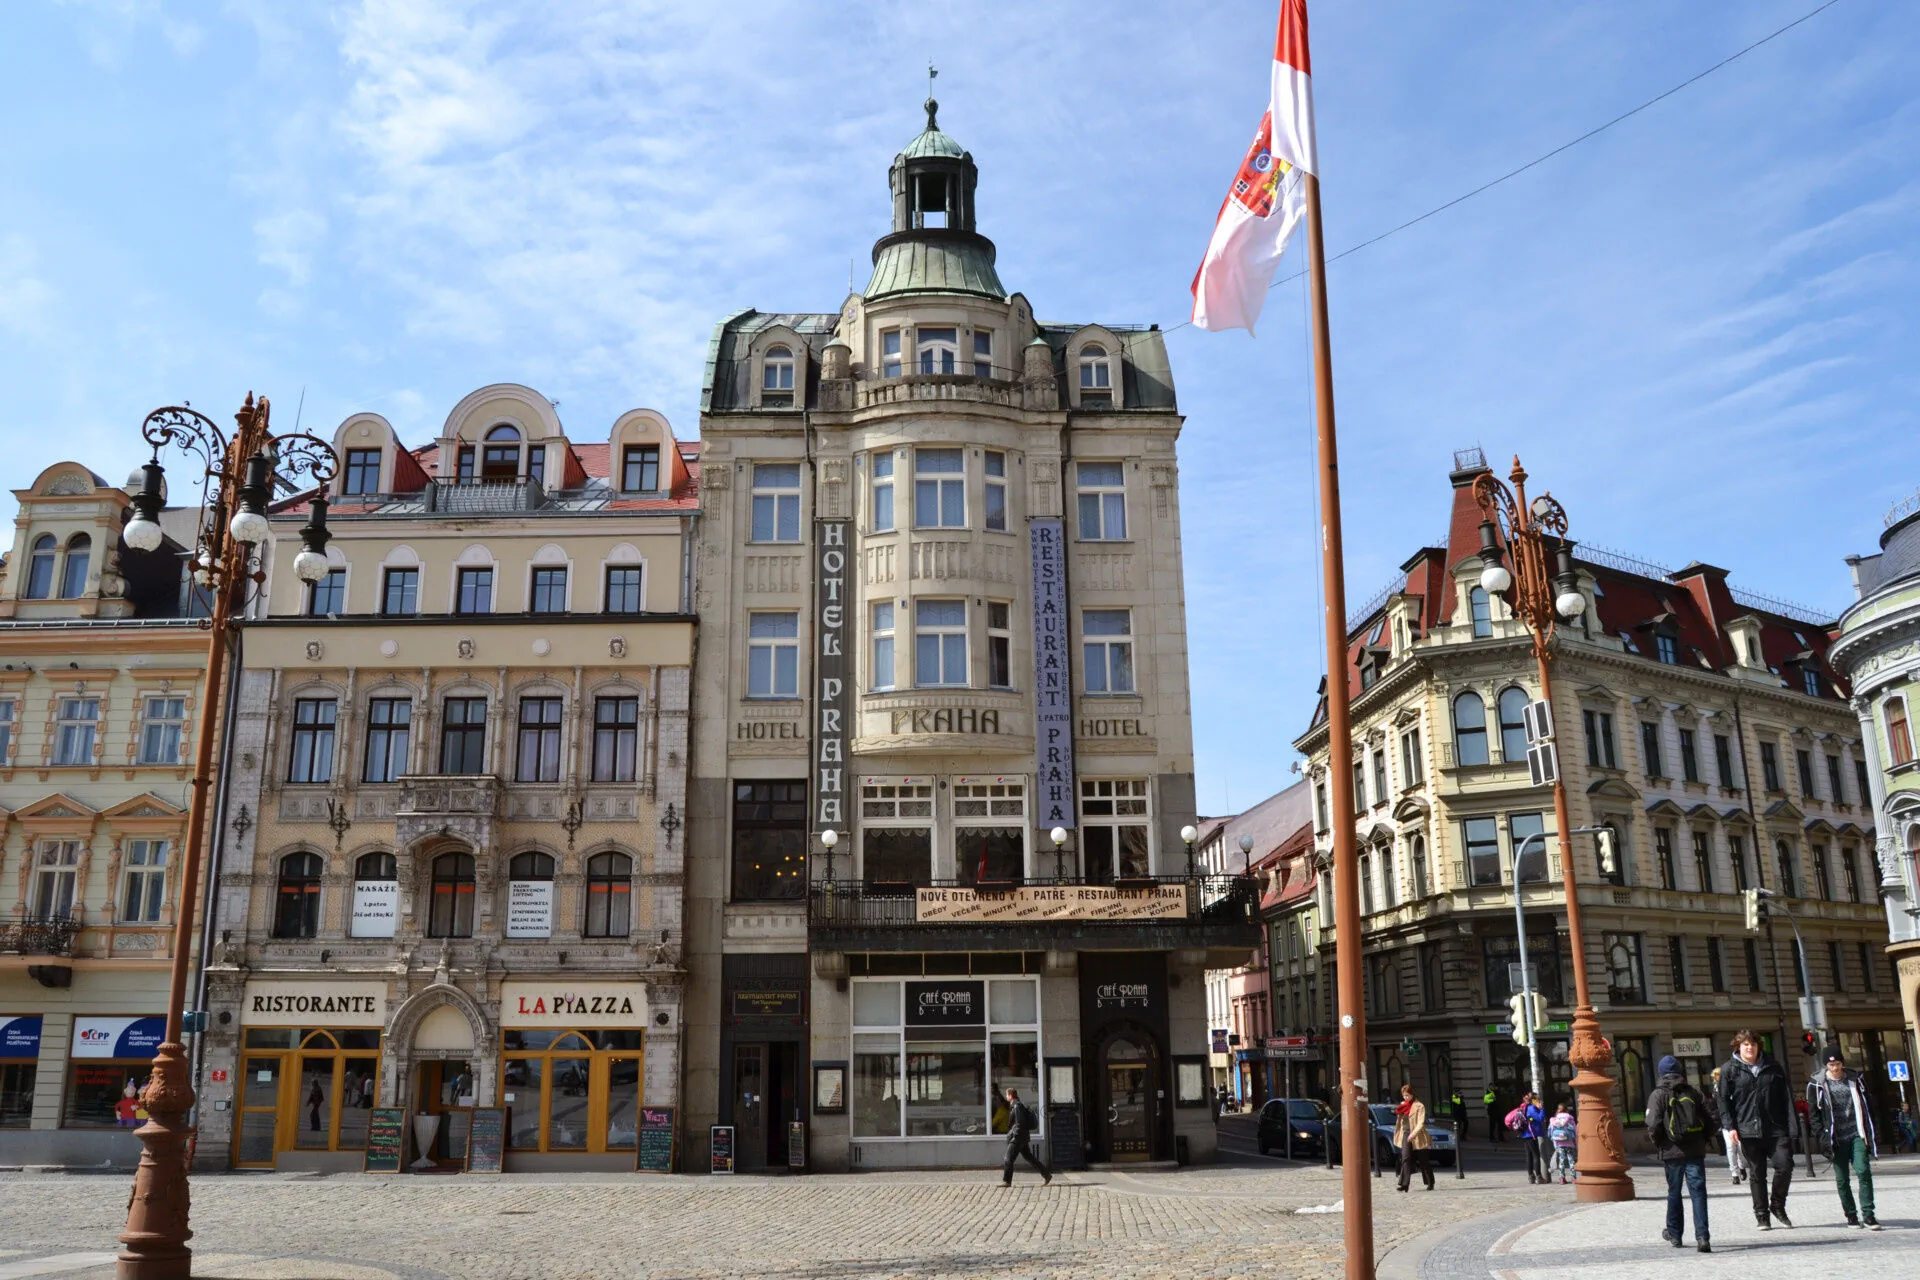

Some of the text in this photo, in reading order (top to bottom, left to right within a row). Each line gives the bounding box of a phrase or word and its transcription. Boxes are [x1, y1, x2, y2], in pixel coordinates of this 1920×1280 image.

[1040, 528, 1060, 706] RESTAURANT
[820, 524, 844, 822] HOTEL PRAHA
[891, 708, 999, 734] PRAHA
[1045, 714, 1069, 722] PATRO
[737, 722, 804, 739] HOTEL
[1081, 719, 1148, 736] HOTEL
[1047, 728, 1065, 820] PRAHA
[920, 890, 948, 902] NOVĚ
[1020, 890, 1029, 901] 1.
[1034, 888, 1065, 900] PATŘE
[1078, 889, 1143, 900] RESTAURANT
[1148, 888, 1182, 899] PRAHA
[922, 905, 948, 918] OBĚDY
[951, 904, 981, 918] VEČEŘE
[982, 902, 1018, 918] MINUTKY
[1016, 906, 1038, 917] MENU
[1042, 904, 1067, 917] RAUTY
[1069, 907, 1085, 916] WIFI
[1107, 907, 1128, 918] AKCE
[1150, 902, 1181, 916] KOUTEK
[919, 989, 971, 1005] CAFÉ PRAHA
[1097, 982, 1148, 997] CAFÉ PRAHA
[252, 996, 375, 1012] RISTORANTE
[518, 997, 546, 1014] LA
